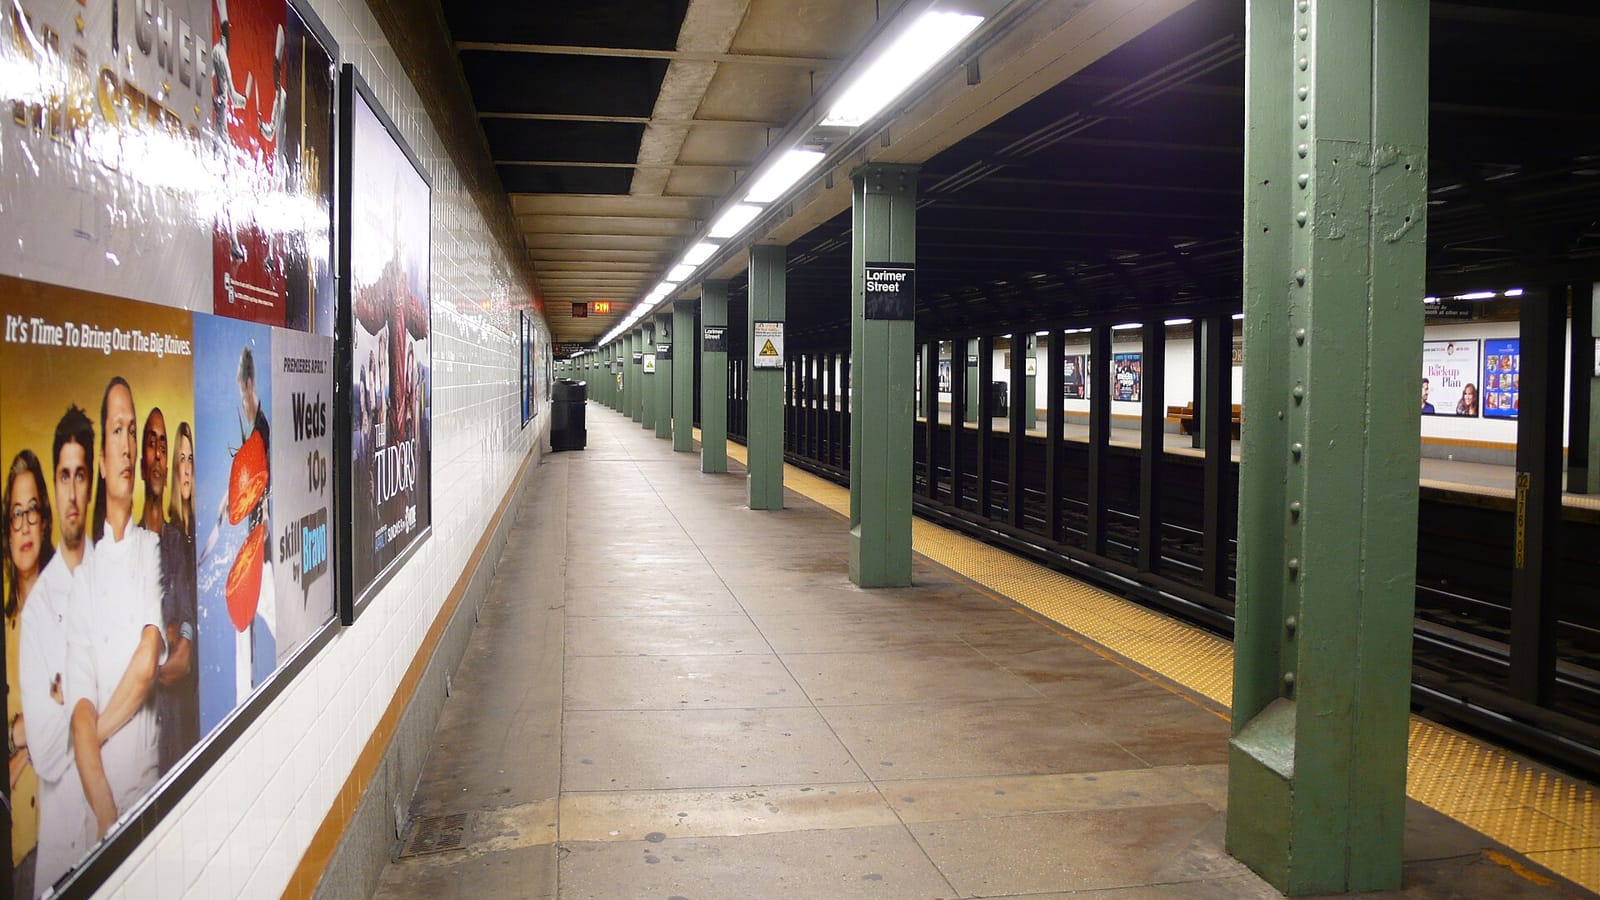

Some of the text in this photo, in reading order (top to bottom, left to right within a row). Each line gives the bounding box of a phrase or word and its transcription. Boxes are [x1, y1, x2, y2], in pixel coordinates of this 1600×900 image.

[866, 270, 907, 281] Lorimer
[866, 281, 900, 292] Street
[5, 315, 191, 358] It's Time To Bring Out The Big Knives.
[283, 357, 311, 373] PREMIERES
[311, 359, 324, 374] APRIL
[1442, 377, 1461, 388] Plan
[292, 392, 326, 442] Weds
[375, 423, 386, 448] THE
[308, 449, 326, 497] 10p
[375, 438, 416, 505] TUDORS
[280, 520, 300, 563] skill
[303, 523, 326, 575] Bravo
[293, 561, 300, 584] by
